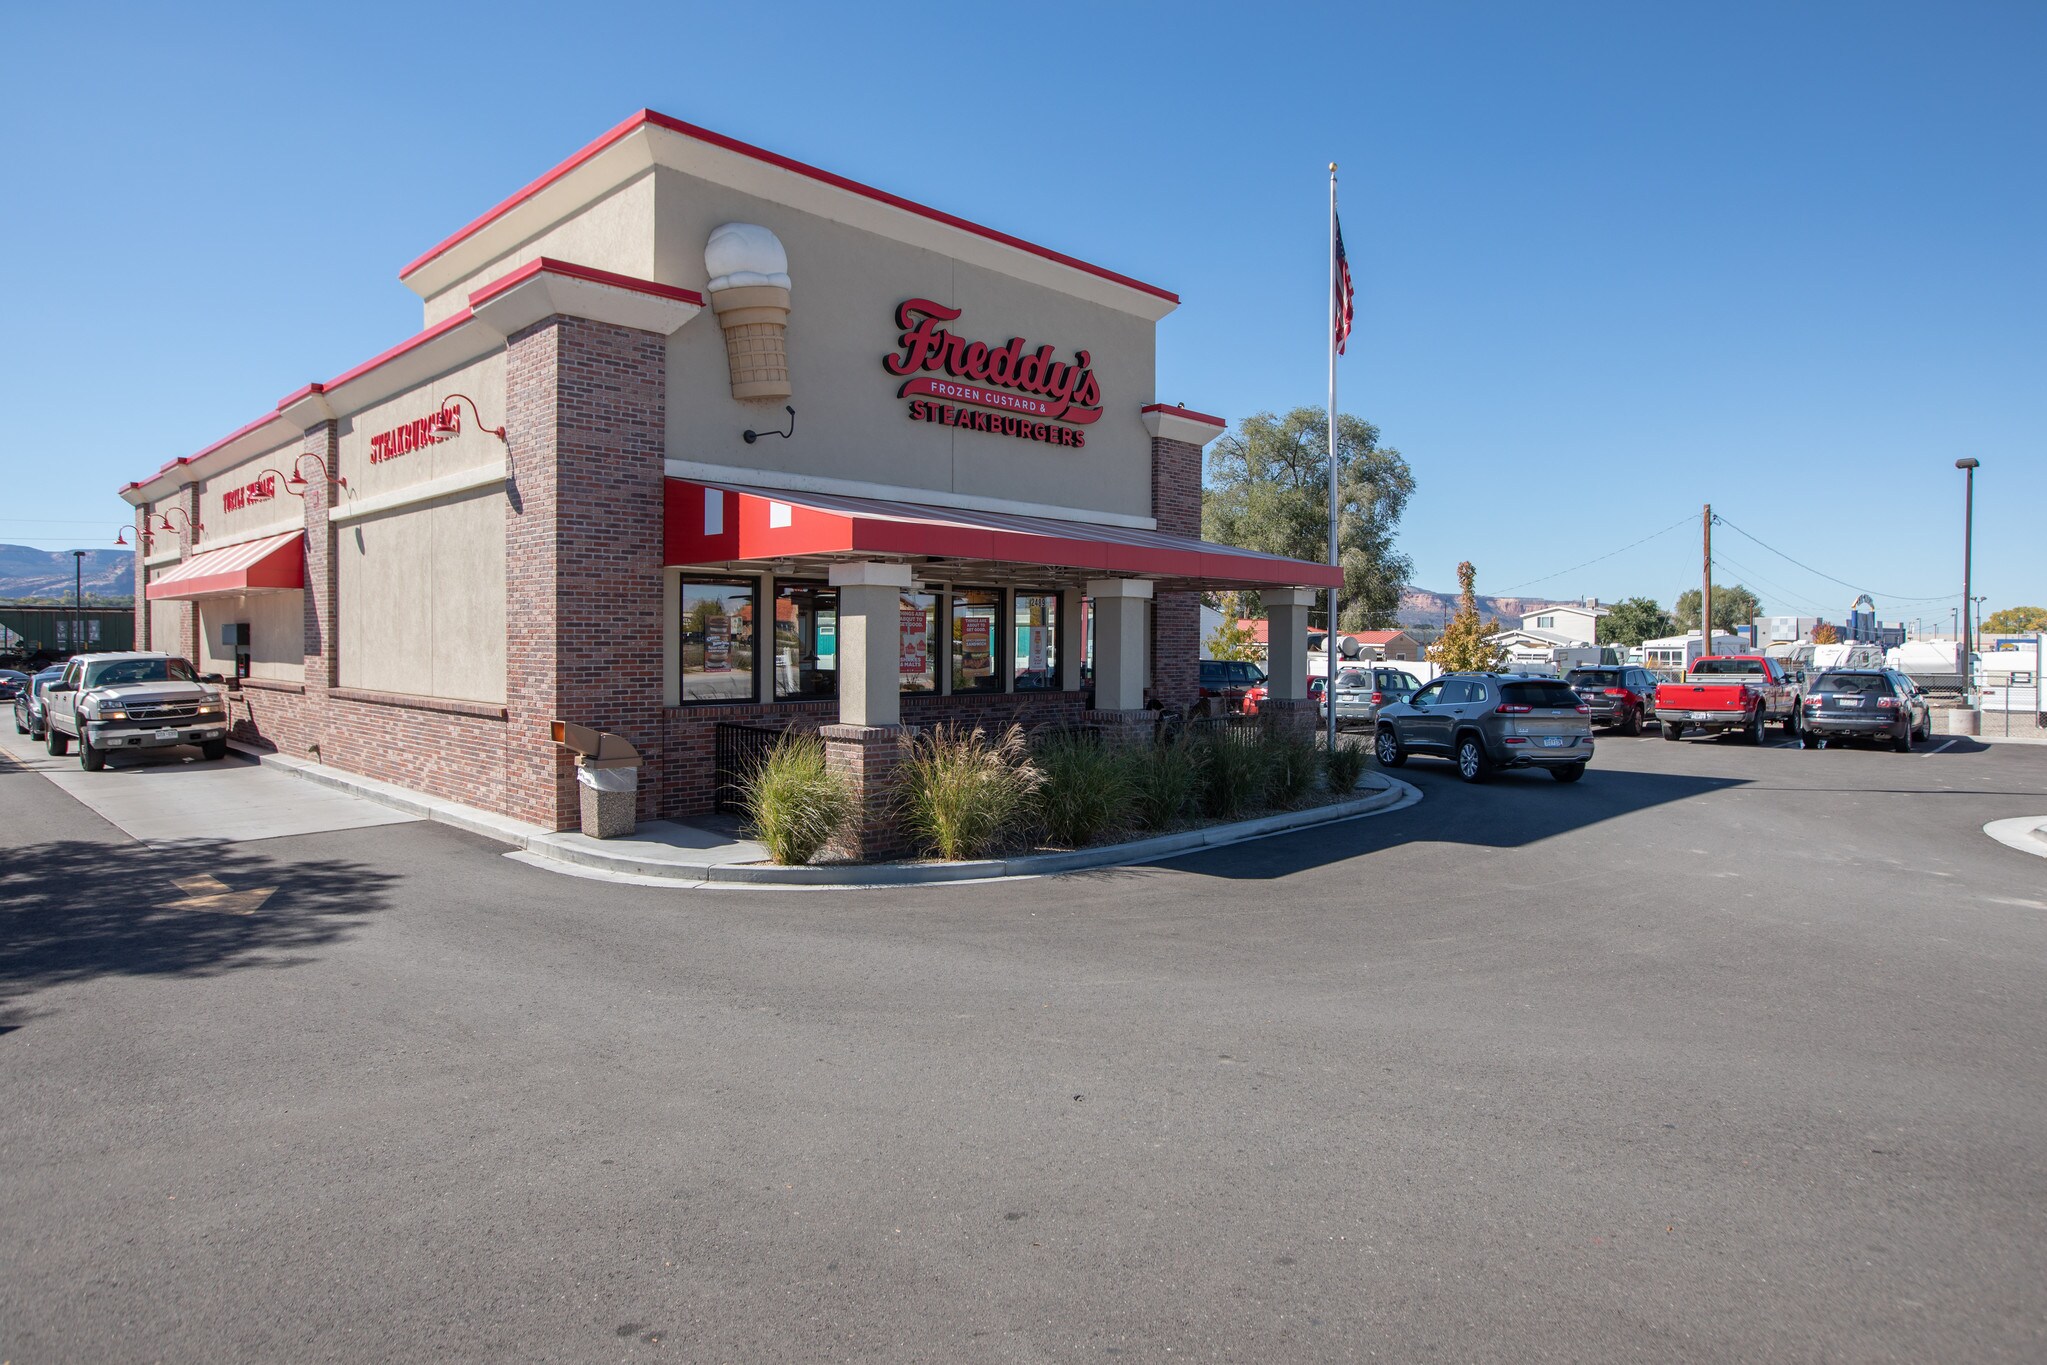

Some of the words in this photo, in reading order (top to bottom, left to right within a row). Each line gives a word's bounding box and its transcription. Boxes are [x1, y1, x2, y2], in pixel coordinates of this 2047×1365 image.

[882, 298, 1101, 412] Freddy's
[931, 382, 980, 401] FROZEN
[985, 393, 1036, 411] CUSTARD
[1039, 404, 1047, 413] &
[909, 399, 1086, 448] STEAKBURGERS
